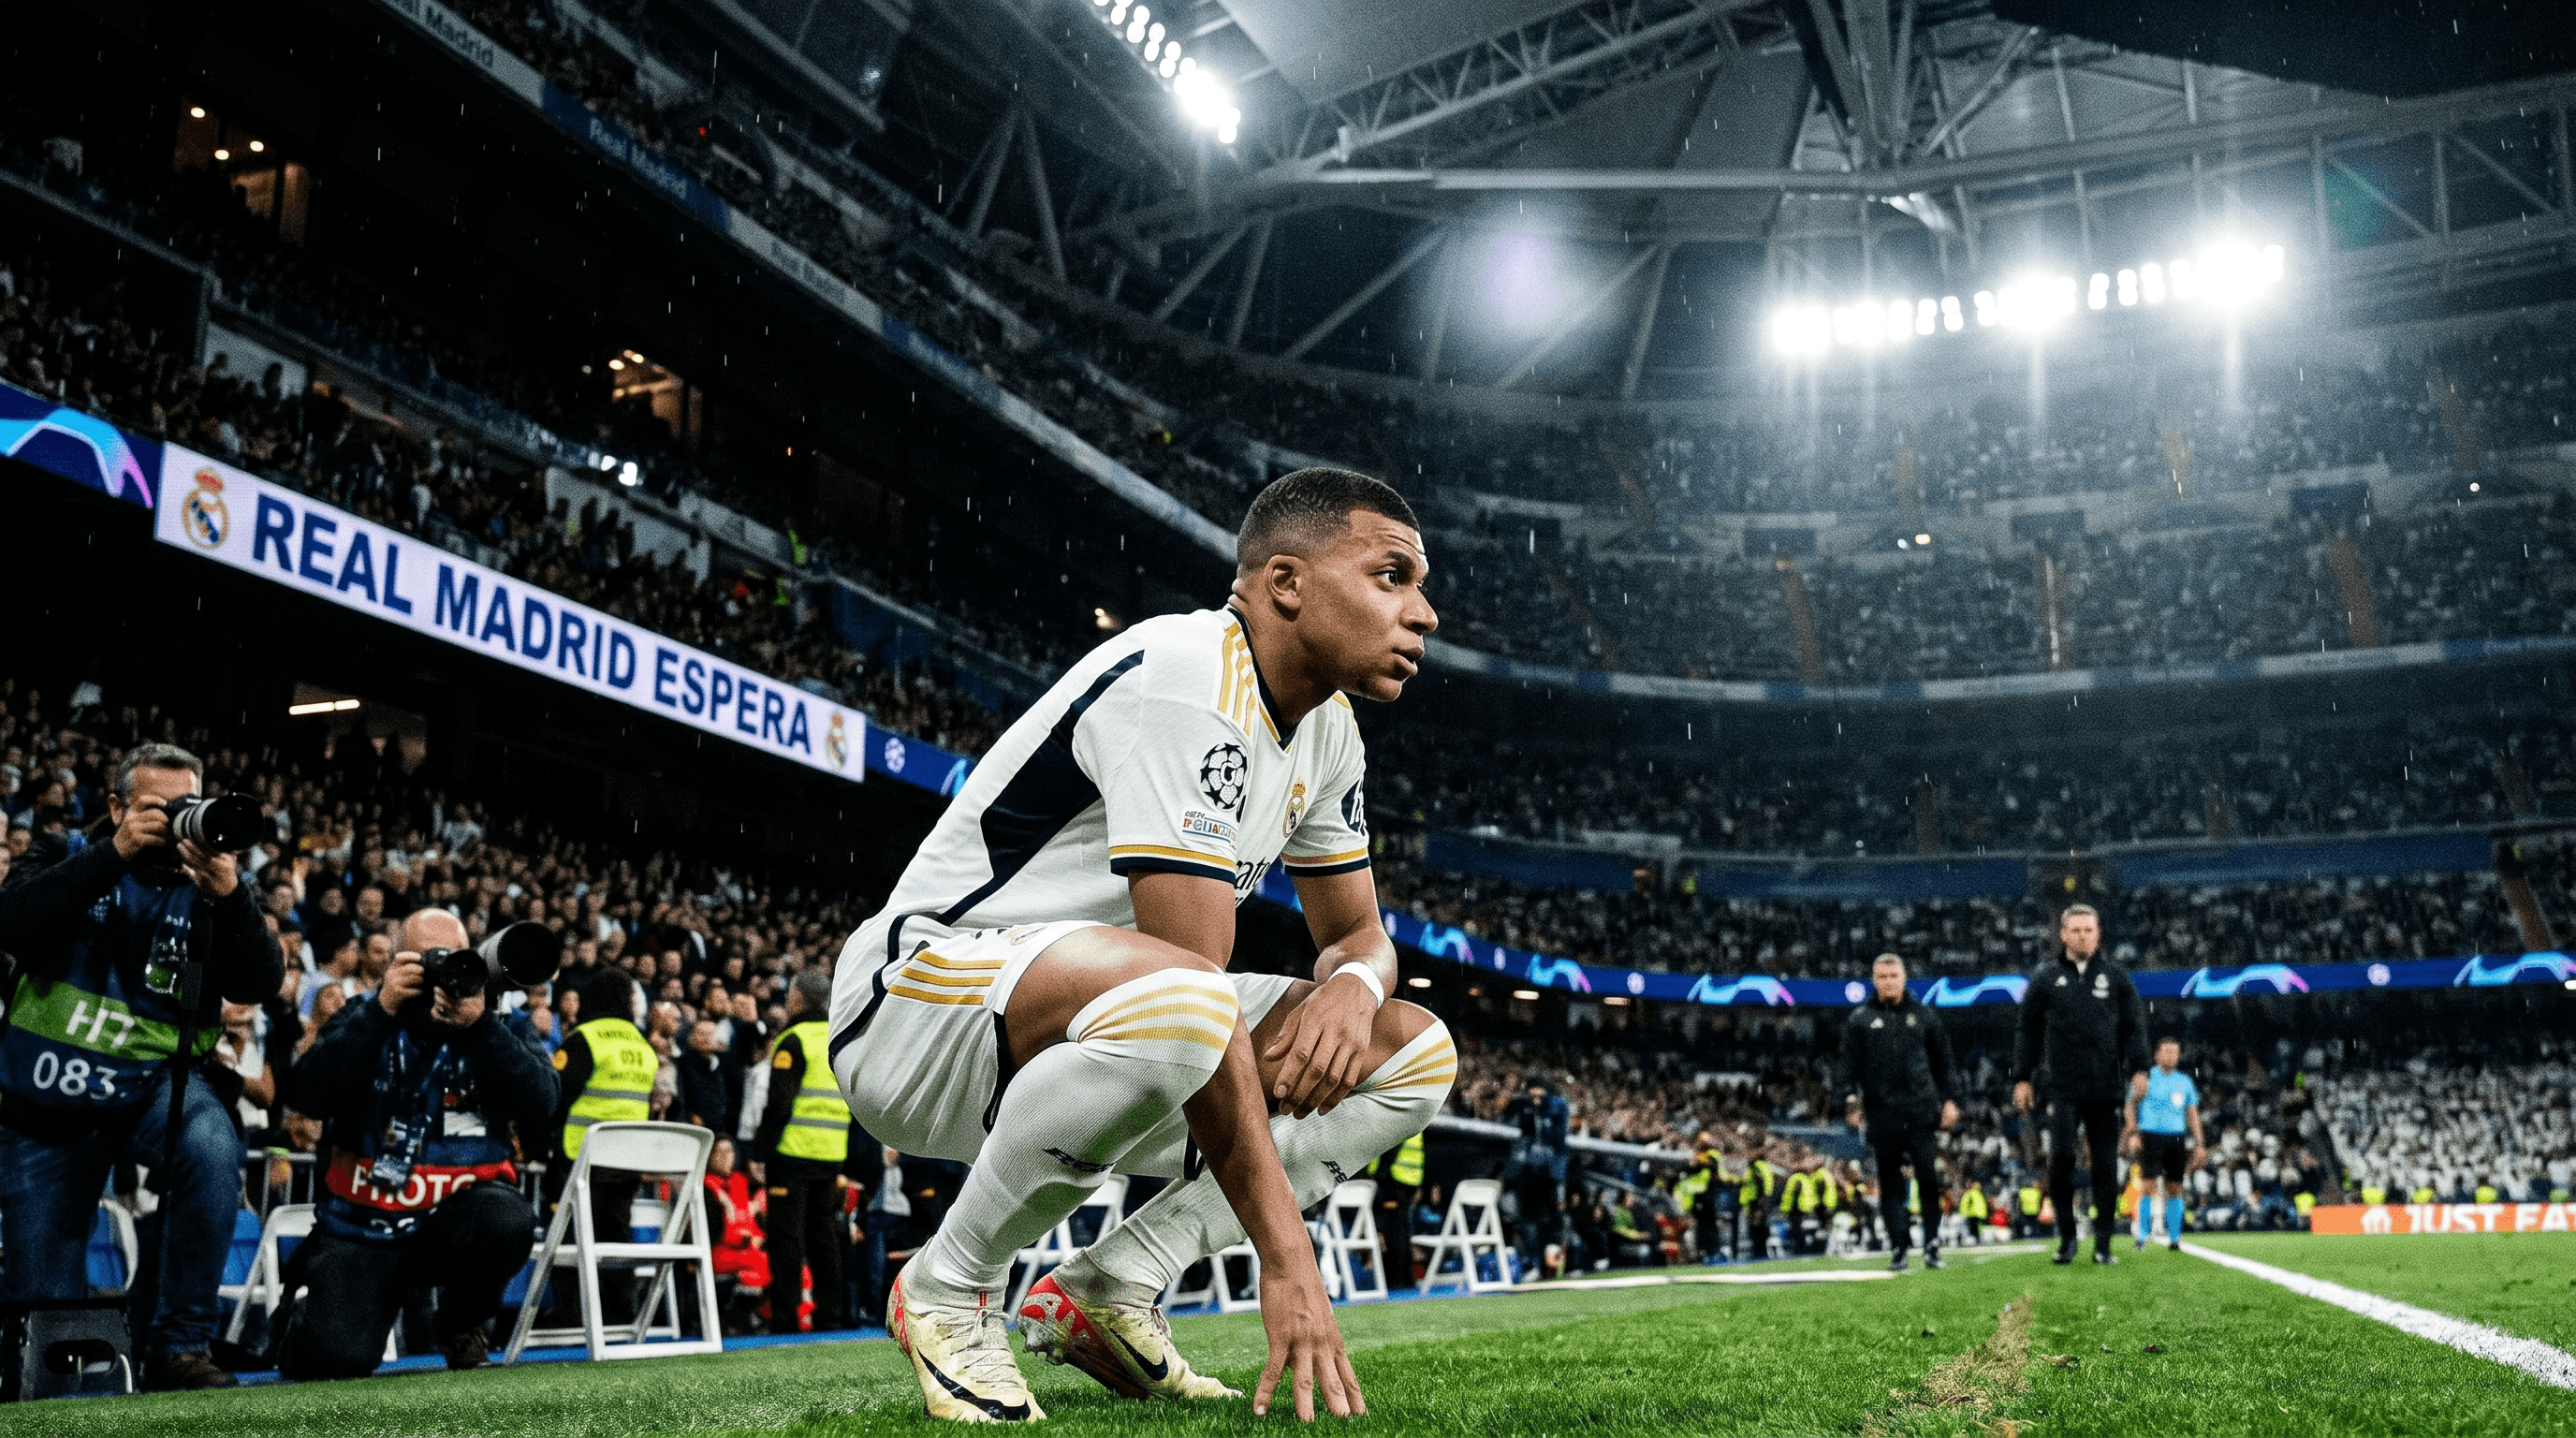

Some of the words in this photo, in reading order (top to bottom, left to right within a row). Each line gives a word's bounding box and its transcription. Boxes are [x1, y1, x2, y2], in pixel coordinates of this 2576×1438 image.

[425, 6, 494, 68] Madrid
[253, 493, 412, 616] REAL
[434, 562, 637, 690] MADRID
[654, 646, 812, 756] ESPERA
[33, 1050, 118, 1100] 083
[2404, 1204, 2506, 1233] JUST
